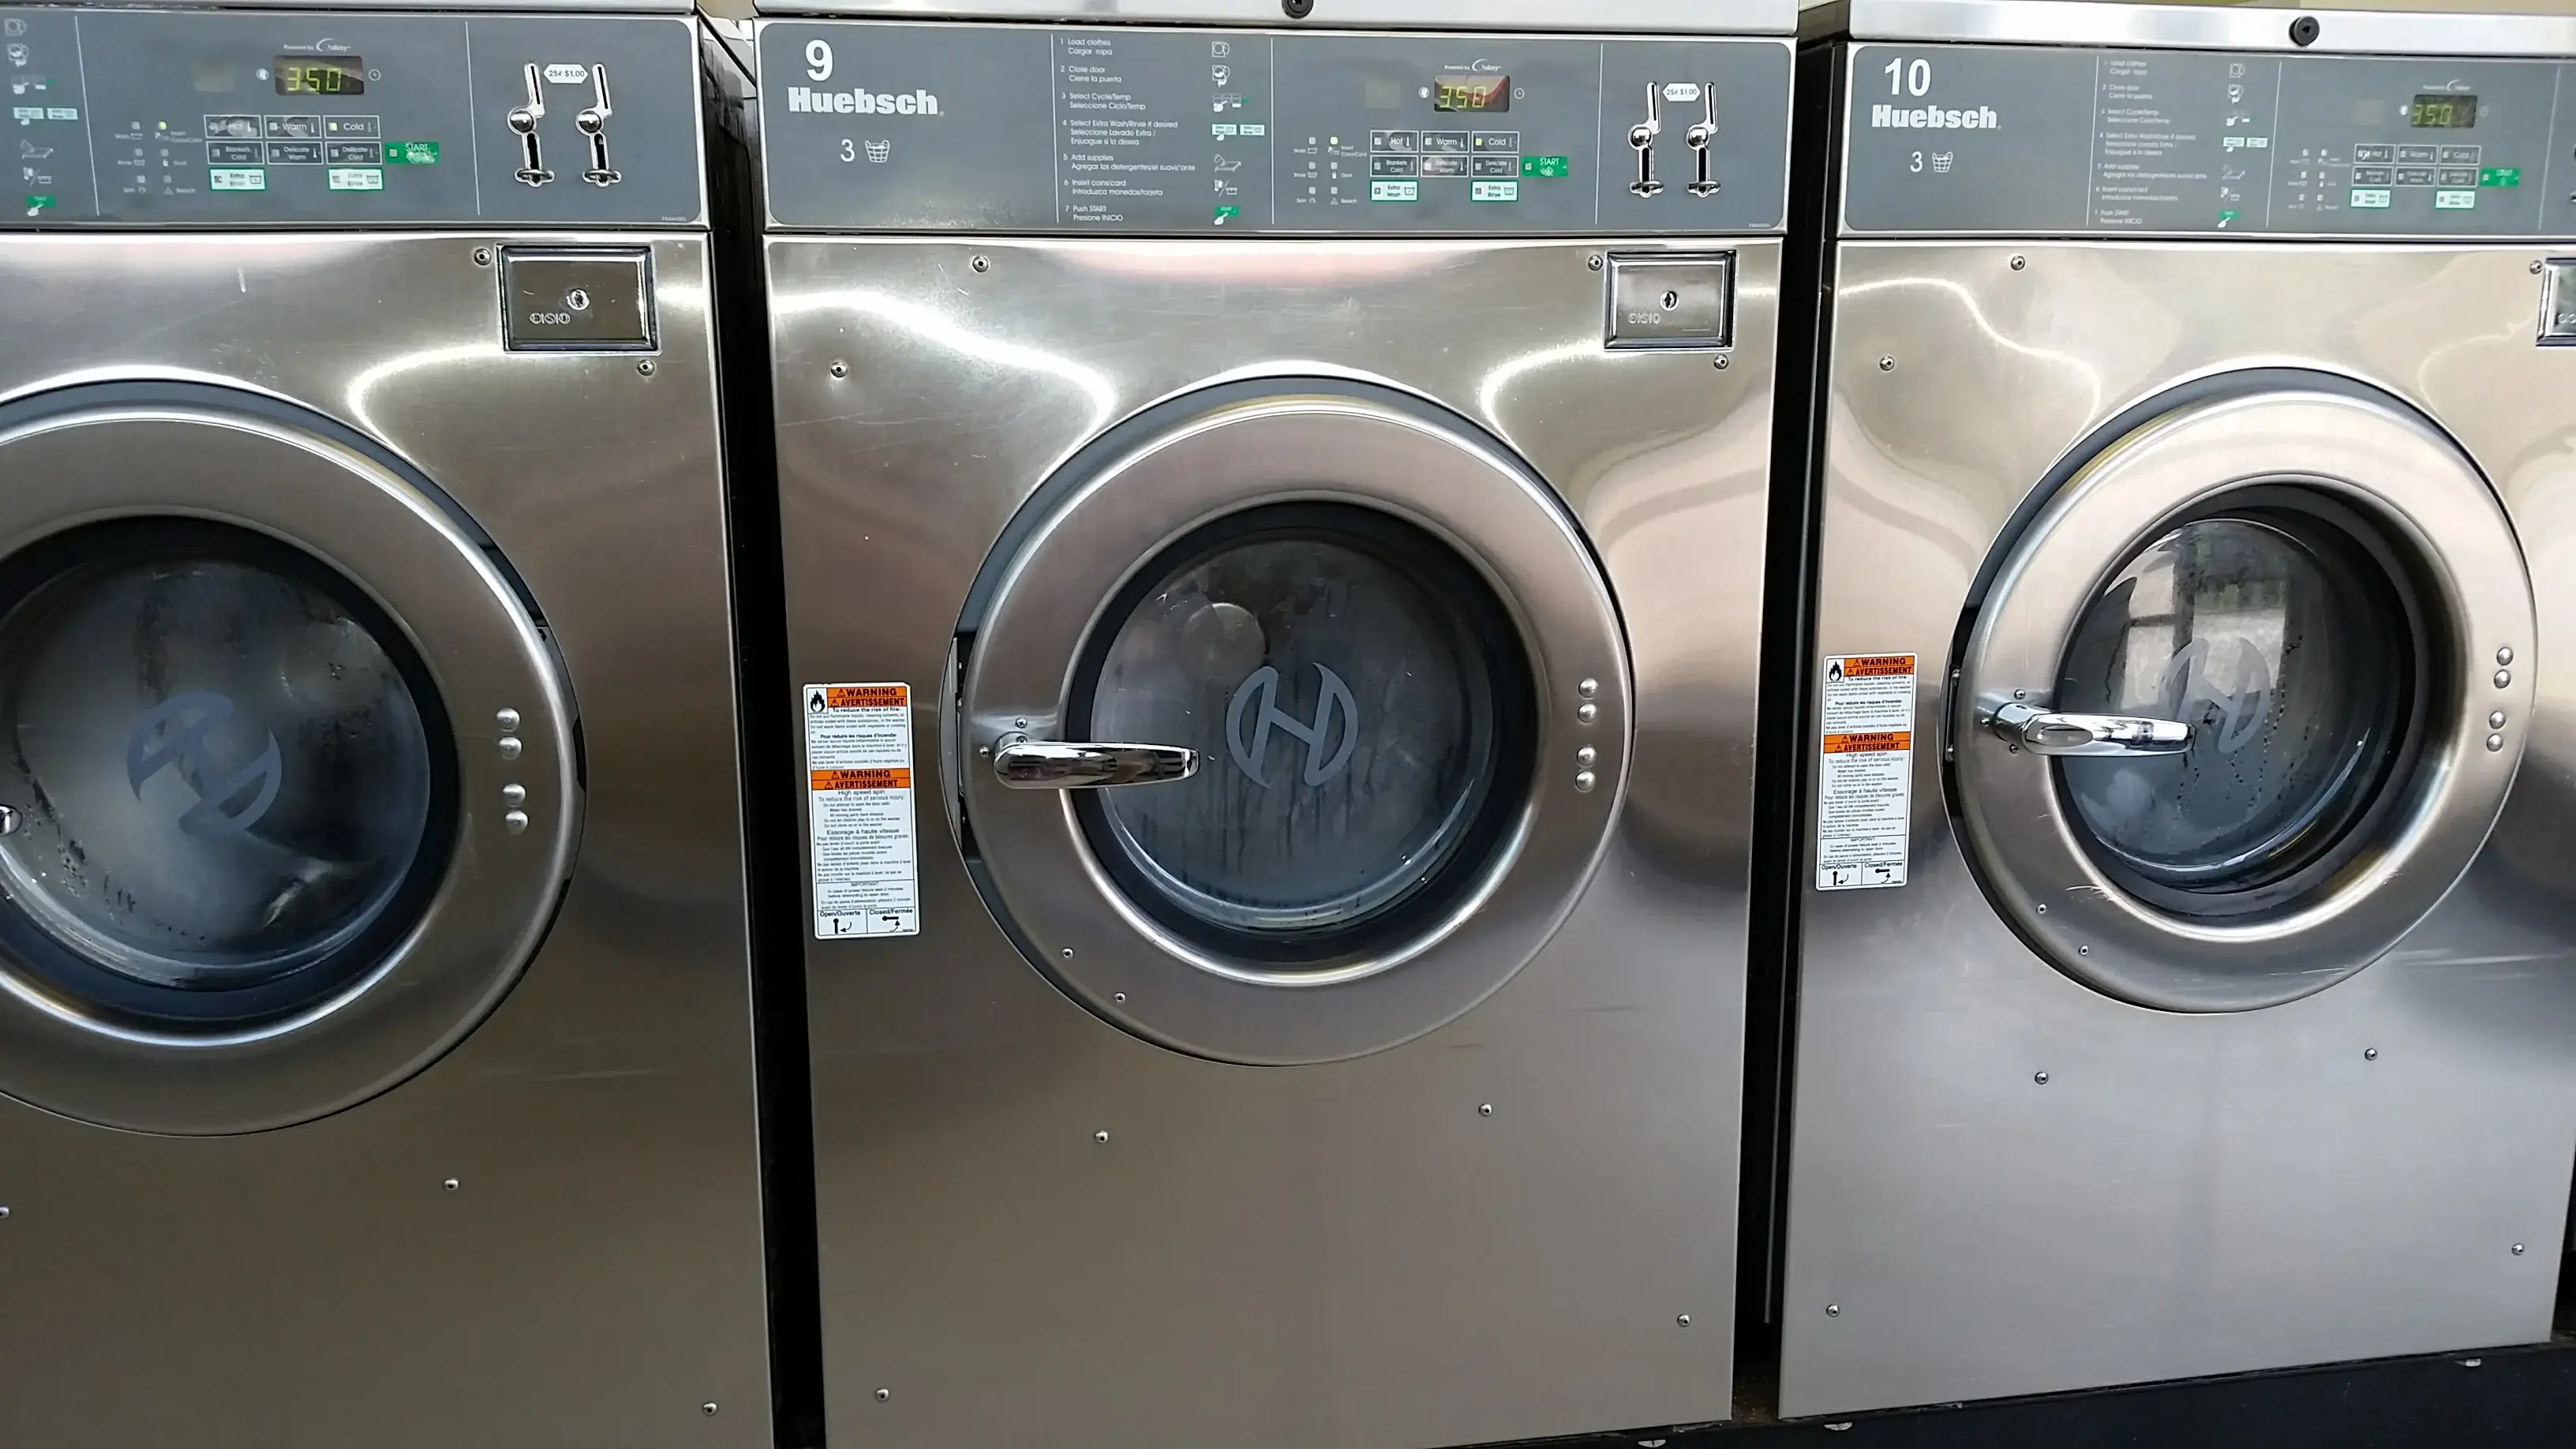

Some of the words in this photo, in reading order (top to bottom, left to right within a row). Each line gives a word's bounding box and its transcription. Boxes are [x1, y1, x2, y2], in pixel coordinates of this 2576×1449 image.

[805, 39, 833, 81] 9
[286, 67, 342, 92] 350
[1885, 58, 1931, 96] 10
[788, 87, 938, 115] Huebsch
[1440, 86, 1486, 108] 350
[1872, 104, 1998, 129] Huebsch
[2412, 103, 2454, 125] 350
[343, 122, 364, 131] Cold
[405, 143, 428, 152] START
[1436, 137, 1458, 146] Warm
[1488, 137, 1506, 146] Cold
[841, 139, 856, 162] 3
[1910, 152, 1923, 172] 3
[846, 688, 897, 697] WARNING
[841, 698, 904, 706] AVERTISSEMENT
[1844, 743, 1900, 751] AVERTISSEMENT
[840, 770, 891, 779] WARNING
[834, 780, 898, 788] AVERTISSEMENT
